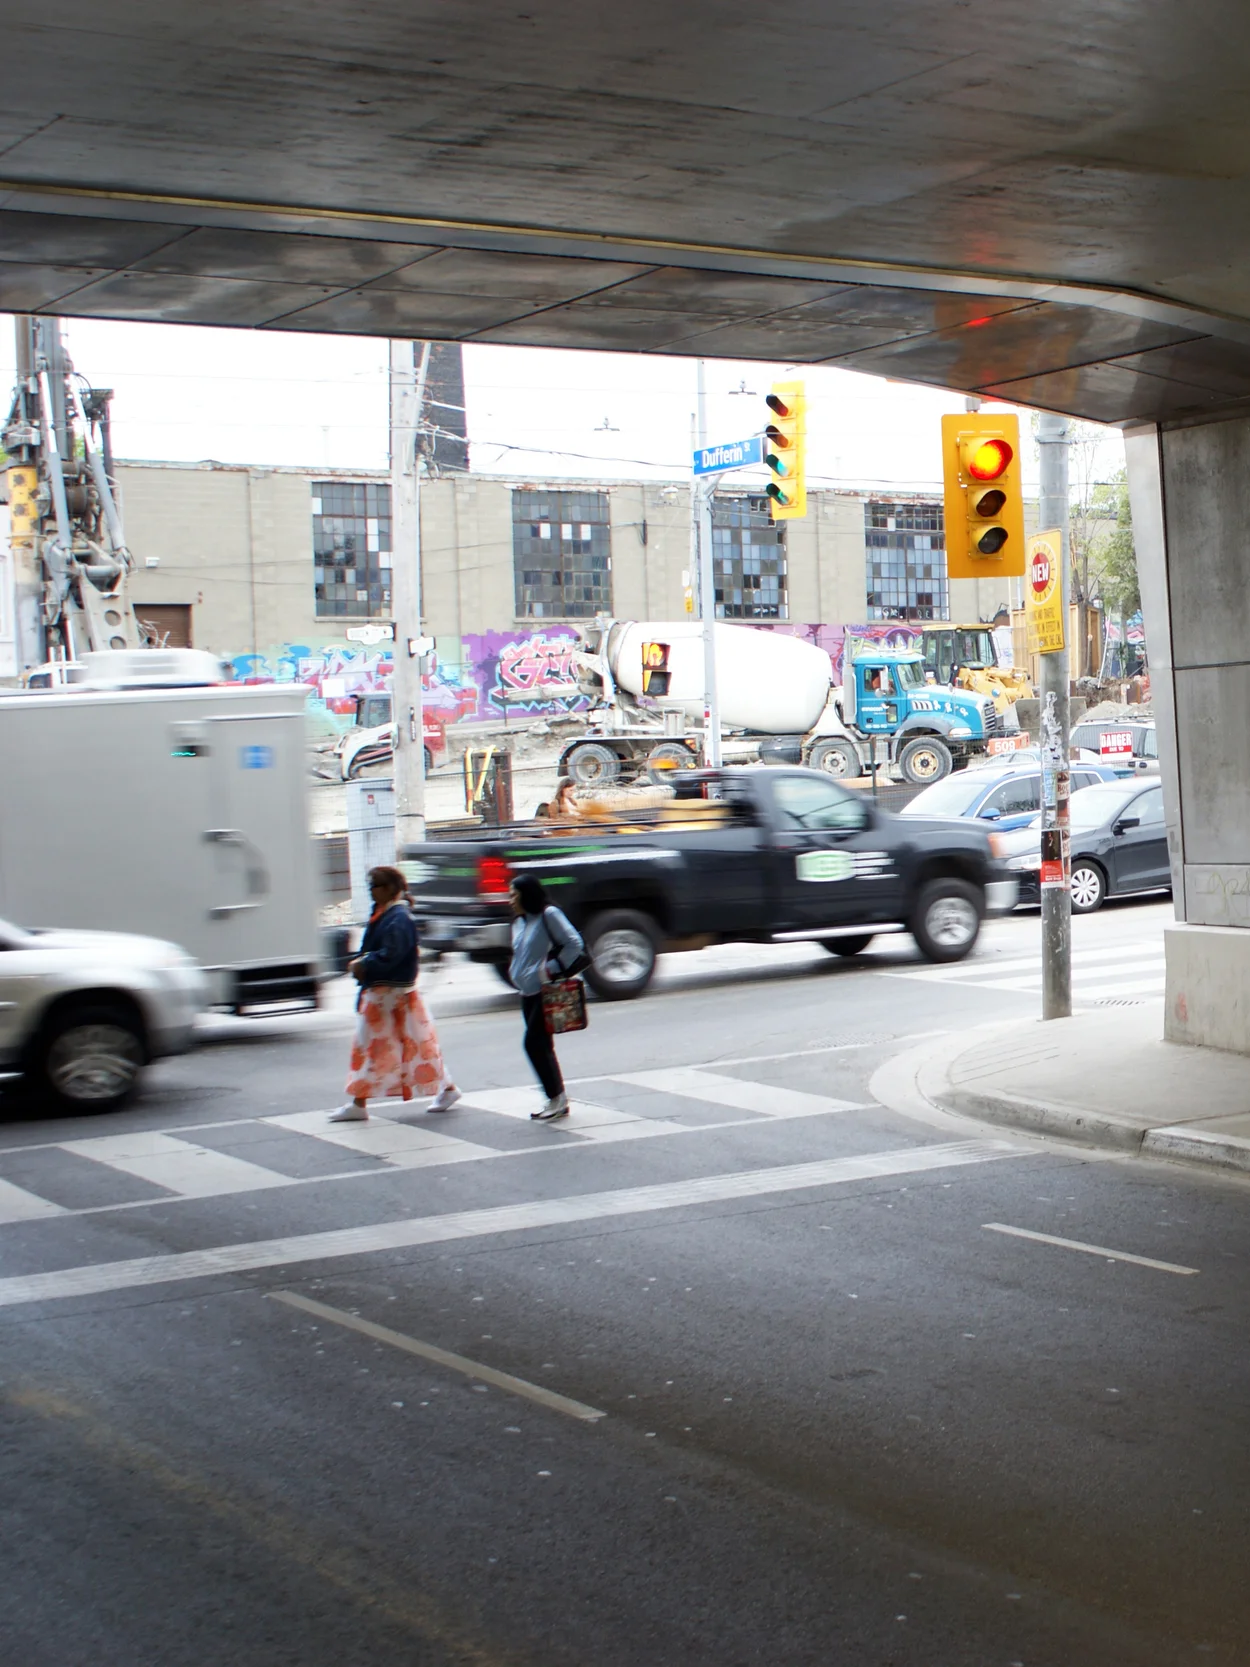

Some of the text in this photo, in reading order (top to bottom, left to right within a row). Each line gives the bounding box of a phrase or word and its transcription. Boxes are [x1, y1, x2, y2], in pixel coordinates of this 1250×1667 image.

[702, 444, 743, 468] Dufferin
[1032, 562, 1049, 583] NEW
[1101, 733, 1132, 748] DANGER
